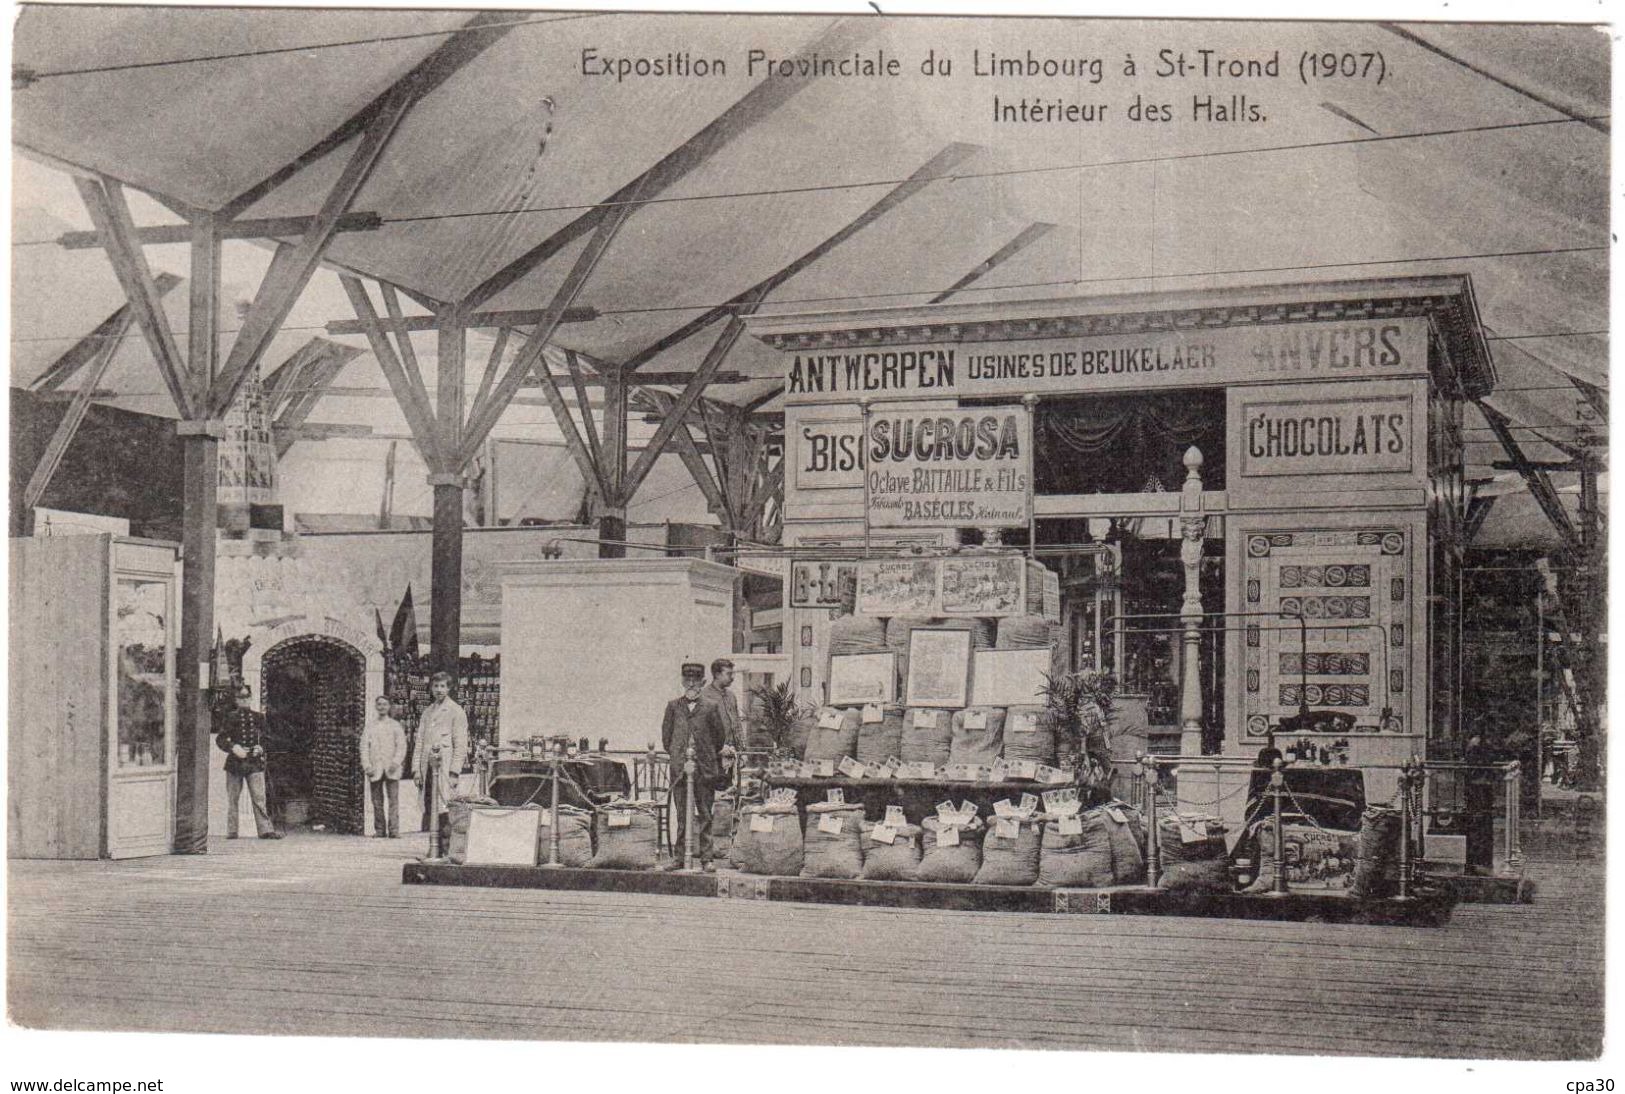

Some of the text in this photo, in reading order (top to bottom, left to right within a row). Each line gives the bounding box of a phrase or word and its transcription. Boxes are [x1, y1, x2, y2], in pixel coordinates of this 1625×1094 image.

[787, 325, 1402, 393] ANTWERPEN USINES DE BEUKELAER ANVERS
[869, 414, 1021, 463] SUCROSA
[1249, 412, 1404, 457] CHOCOLATS
[869, 470, 910, 494] Octave
[984, 477, 994, 491] &
[993, 467, 1026, 492] Fils
